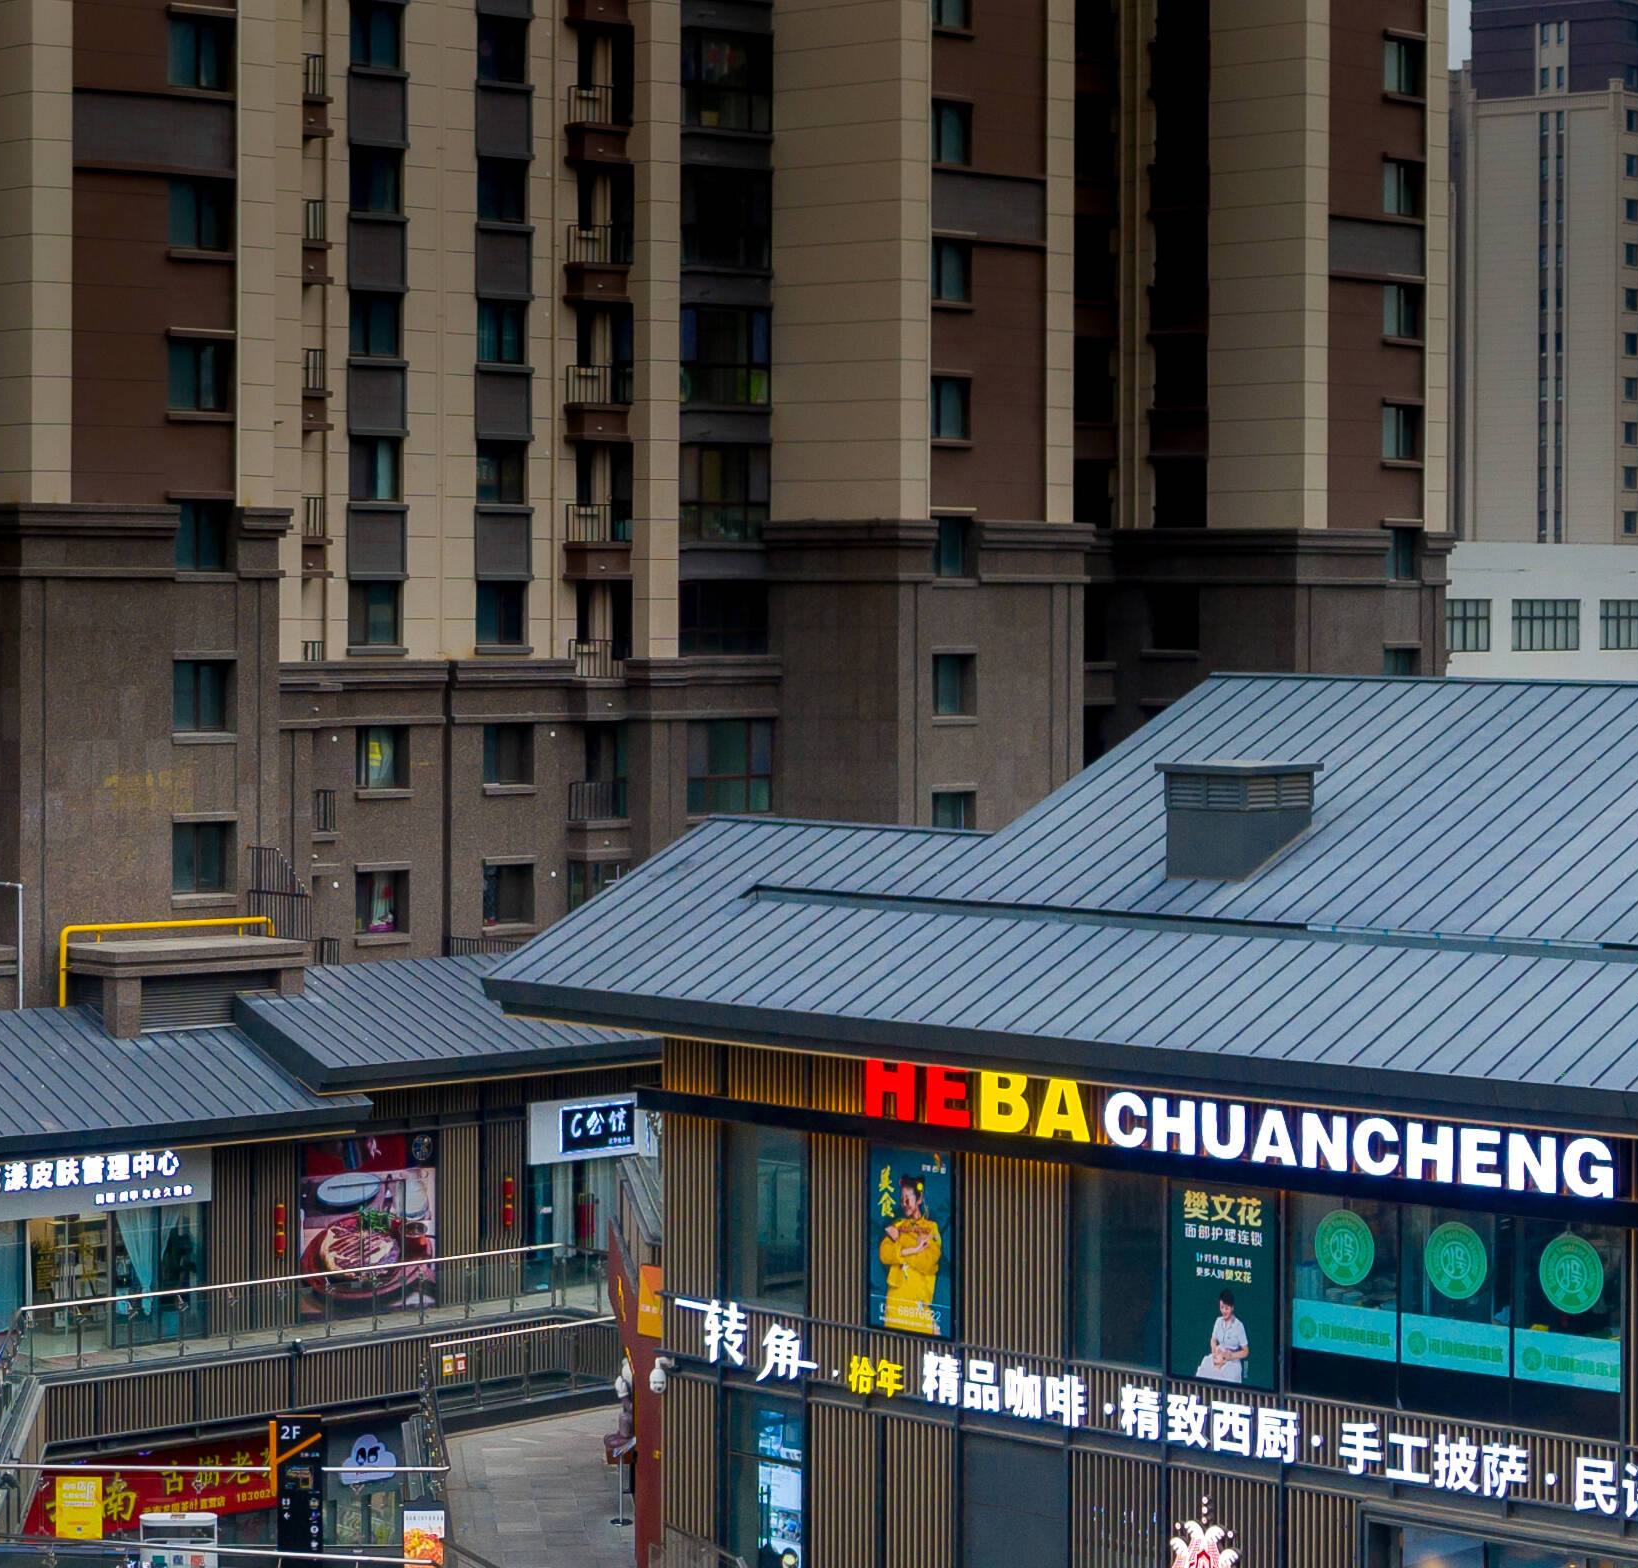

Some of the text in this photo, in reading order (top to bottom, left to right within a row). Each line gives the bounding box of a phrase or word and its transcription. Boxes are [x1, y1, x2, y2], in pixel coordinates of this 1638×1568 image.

[1104, 1091, 1615, 1199] CHUANCHENG
[1184, 1189, 1262, 1227] 樊文花
[280, 1426, 301, 1440] 2F
[922, 1351, 1088, 1429] 精品咖啡
[1120, 1382, 1300, 1464] 精致西厨
[1339, 1420, 1530, 1499] 手工披萨
